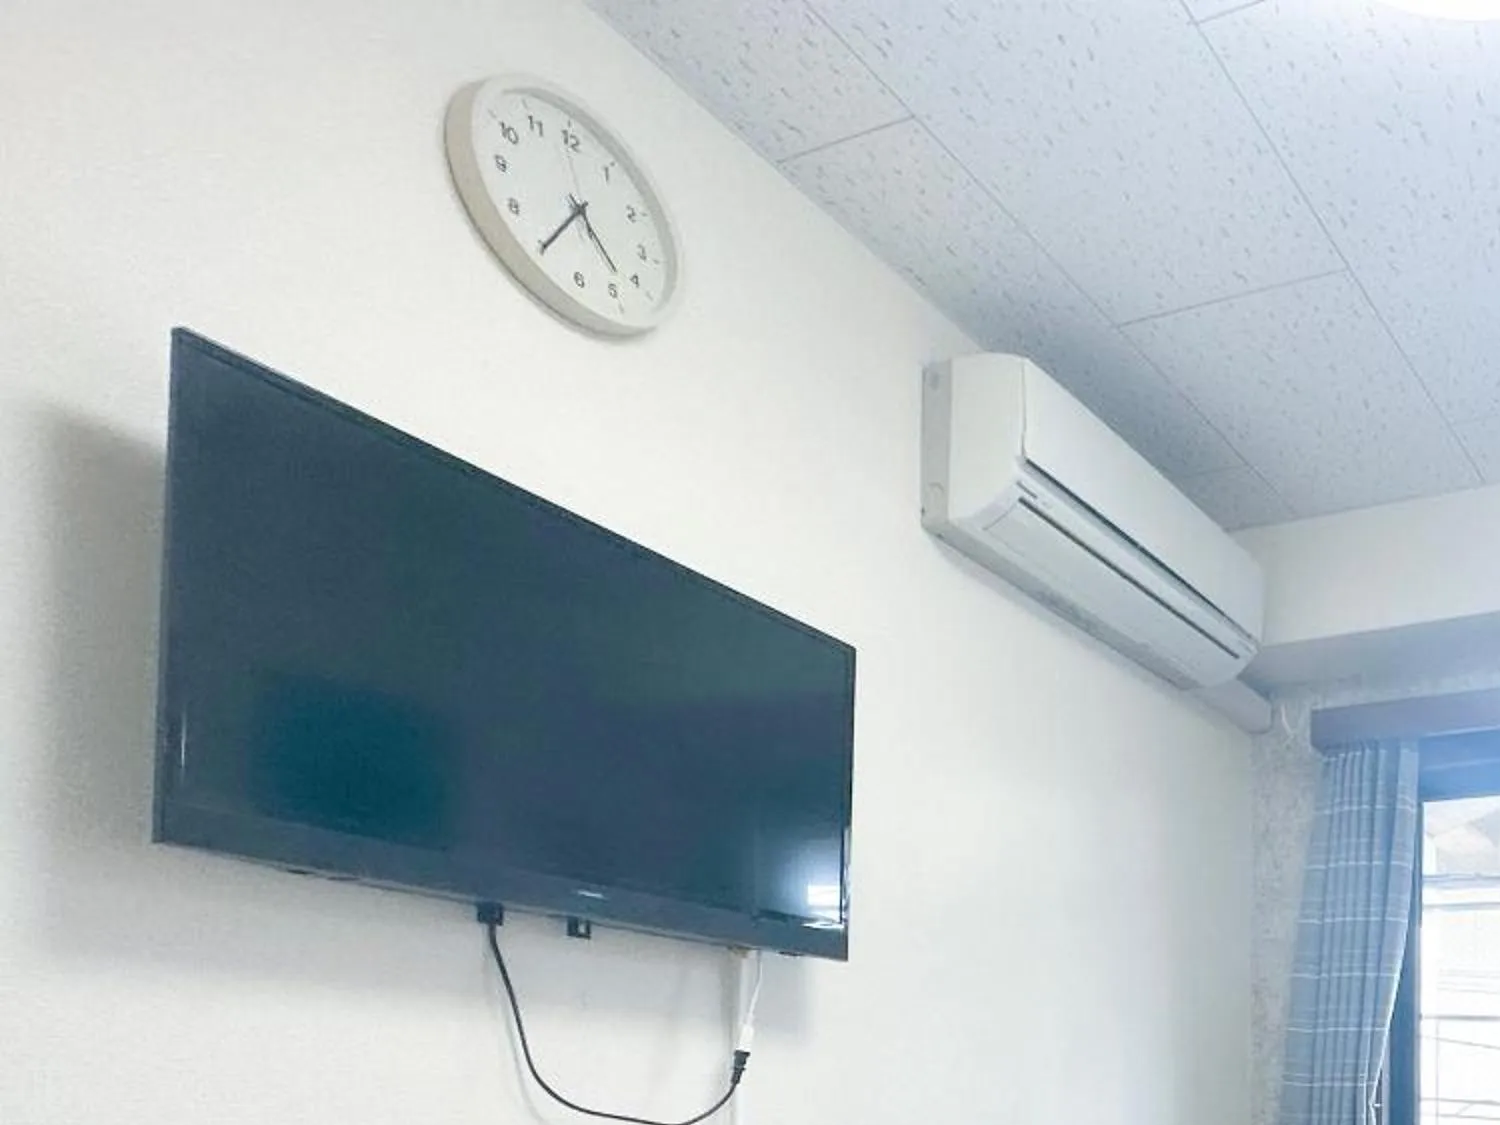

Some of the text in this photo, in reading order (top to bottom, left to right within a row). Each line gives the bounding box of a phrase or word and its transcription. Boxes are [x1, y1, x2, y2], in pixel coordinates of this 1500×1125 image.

[499, 120, 519, 145] 10
[528, 115, 545, 137] 11
[561, 129, 581, 153] 12
[626, 204, 637, 223] 2
[573, 271, 586, 288] 6
[629, 273, 640, 288] 4
